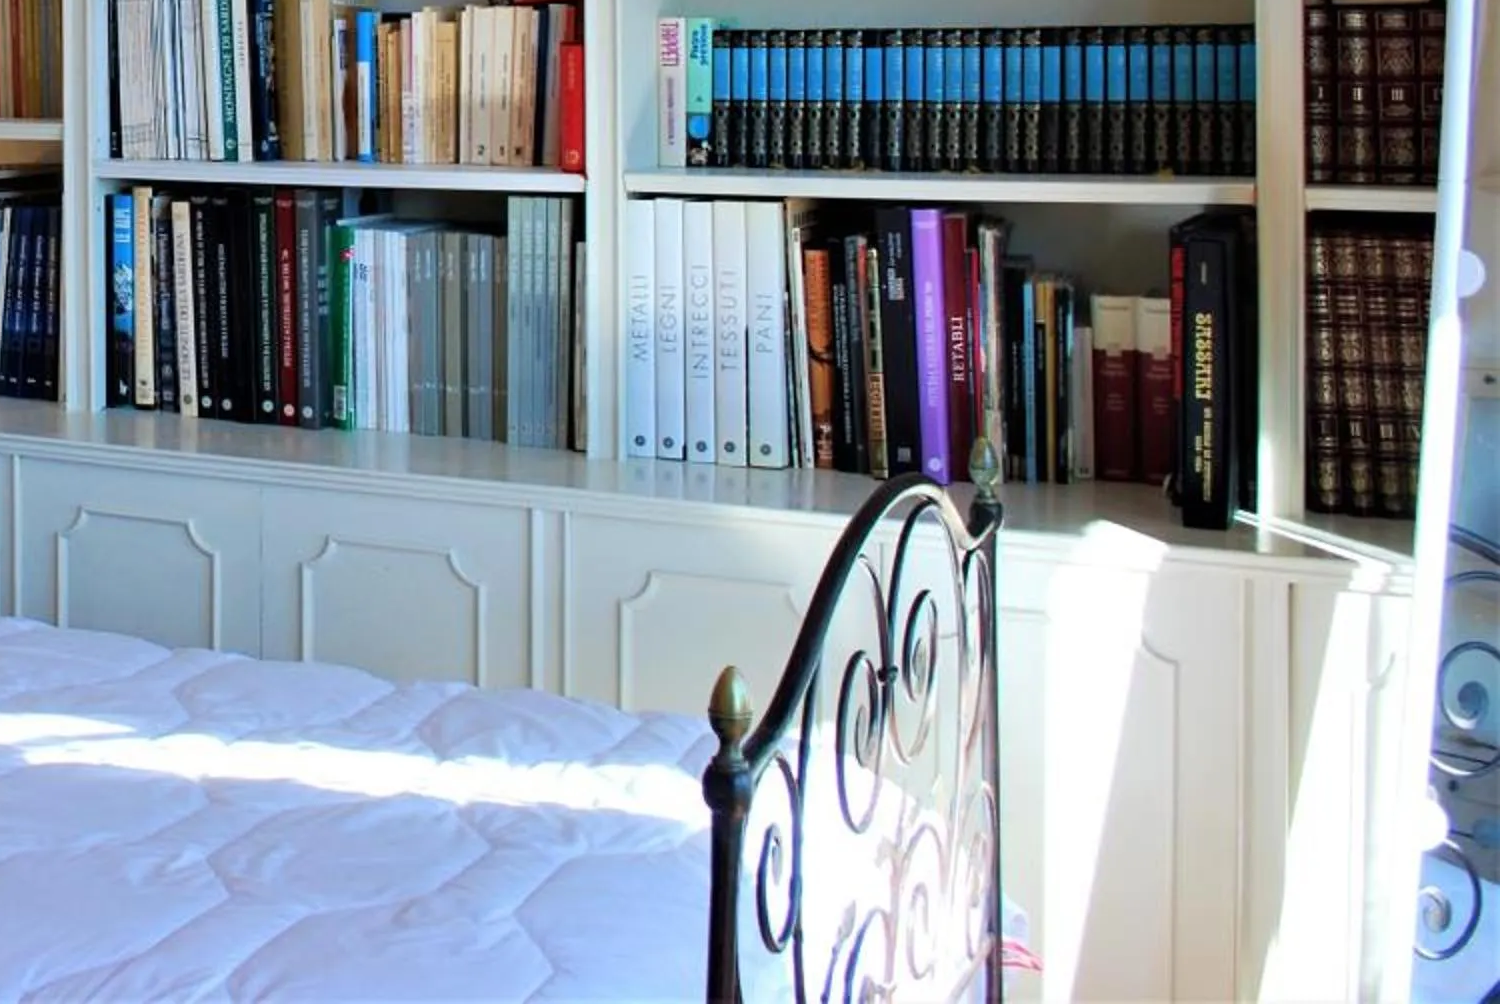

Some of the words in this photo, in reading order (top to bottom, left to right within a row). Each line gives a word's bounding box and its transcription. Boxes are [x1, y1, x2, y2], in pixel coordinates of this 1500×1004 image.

[630, 275, 649, 362] METALLI
[659, 285, 677, 354] LEGNI
[690, 265, 709, 379] INTRECCI
[720, 270, 738, 372] TESSUTI
[755, 294, 773, 354] PANI
[951, 315, 965, 382] RETABLI
